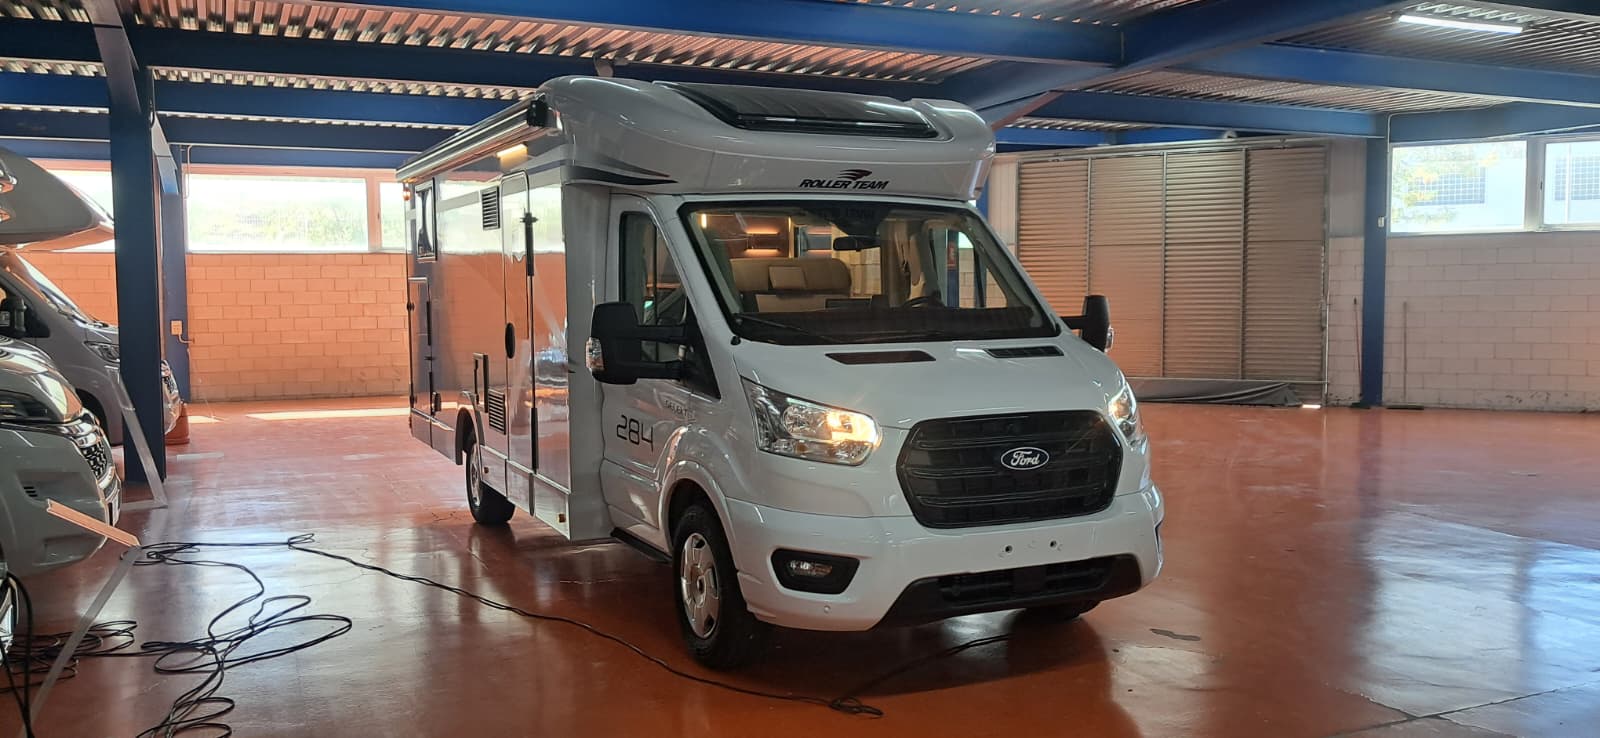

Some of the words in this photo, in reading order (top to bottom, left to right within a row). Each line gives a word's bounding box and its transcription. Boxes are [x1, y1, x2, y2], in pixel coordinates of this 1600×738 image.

[799, 179, 851, 189] ROLLER
[852, 180, 889, 190] TEAM
[616, 414, 654, 453] 284
[1010, 450, 1040, 466] Ford
